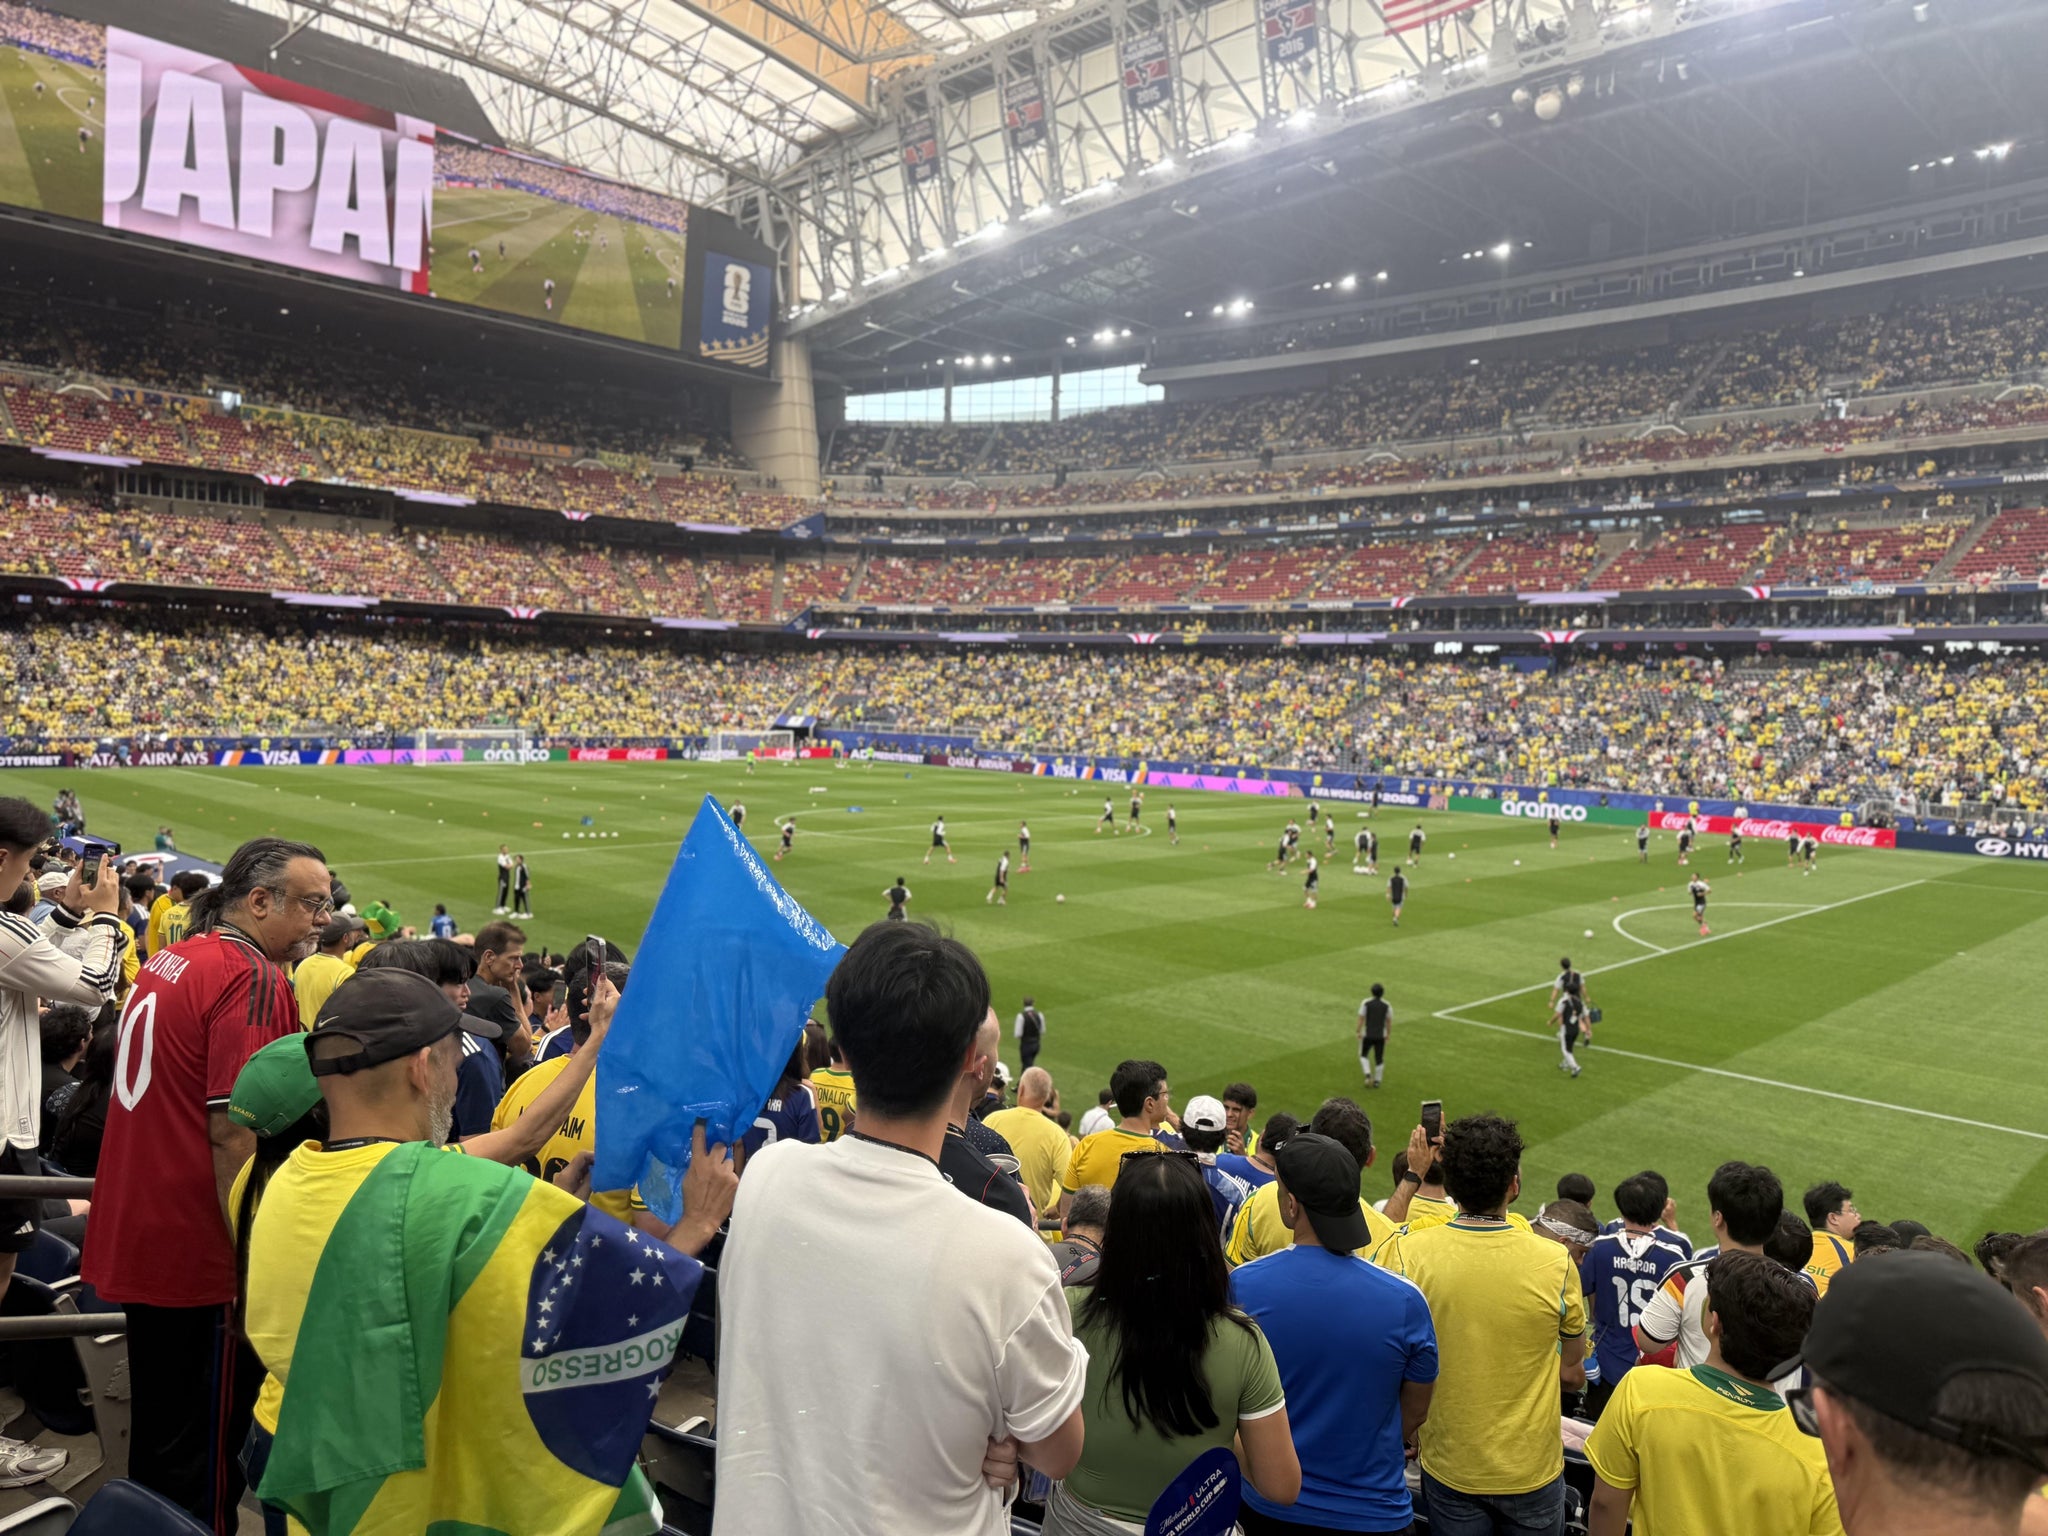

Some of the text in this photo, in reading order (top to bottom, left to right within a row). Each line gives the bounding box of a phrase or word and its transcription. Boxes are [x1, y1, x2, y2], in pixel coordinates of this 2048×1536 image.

[1279, 37, 1304, 57] 2016
[1136, 86, 1160, 104] 2015
[1602, 501, 1655, 512] HOUSTON
[1828, 585, 1896, 597] HOUTON
[261, 751, 301, 765] VISA
[948, 756, 1013, 772] QATAR AIRWAYS
[1052, 763, 1077, 778] VISA
[1102, 768, 1128, 782] VISA
[1310, 787, 1330, 797] FIFA
[1330, 788, 1362, 800] WORLD
[1383, 792, 1418, 805] 2026
[1501, 800, 1587, 822] aramco
[1738, 818, 1790, 839] Coca-Cola
[1821, 825, 1876, 847] Coca-Cola
[142, 949, 190, 985] CUNHA
[816, 1087, 851, 1106] ONALDO
[821, 1107, 840, 1143] 9
[532, 1327, 681, 1387] ROGRESSO
[1716, 1386, 1756, 1406] PENALTY
[1195, 1468, 1222, 1498] ULTRA
[1174, 1505, 1201, 1533] WORLD
[1200, 1491, 1214, 1508] CUP
